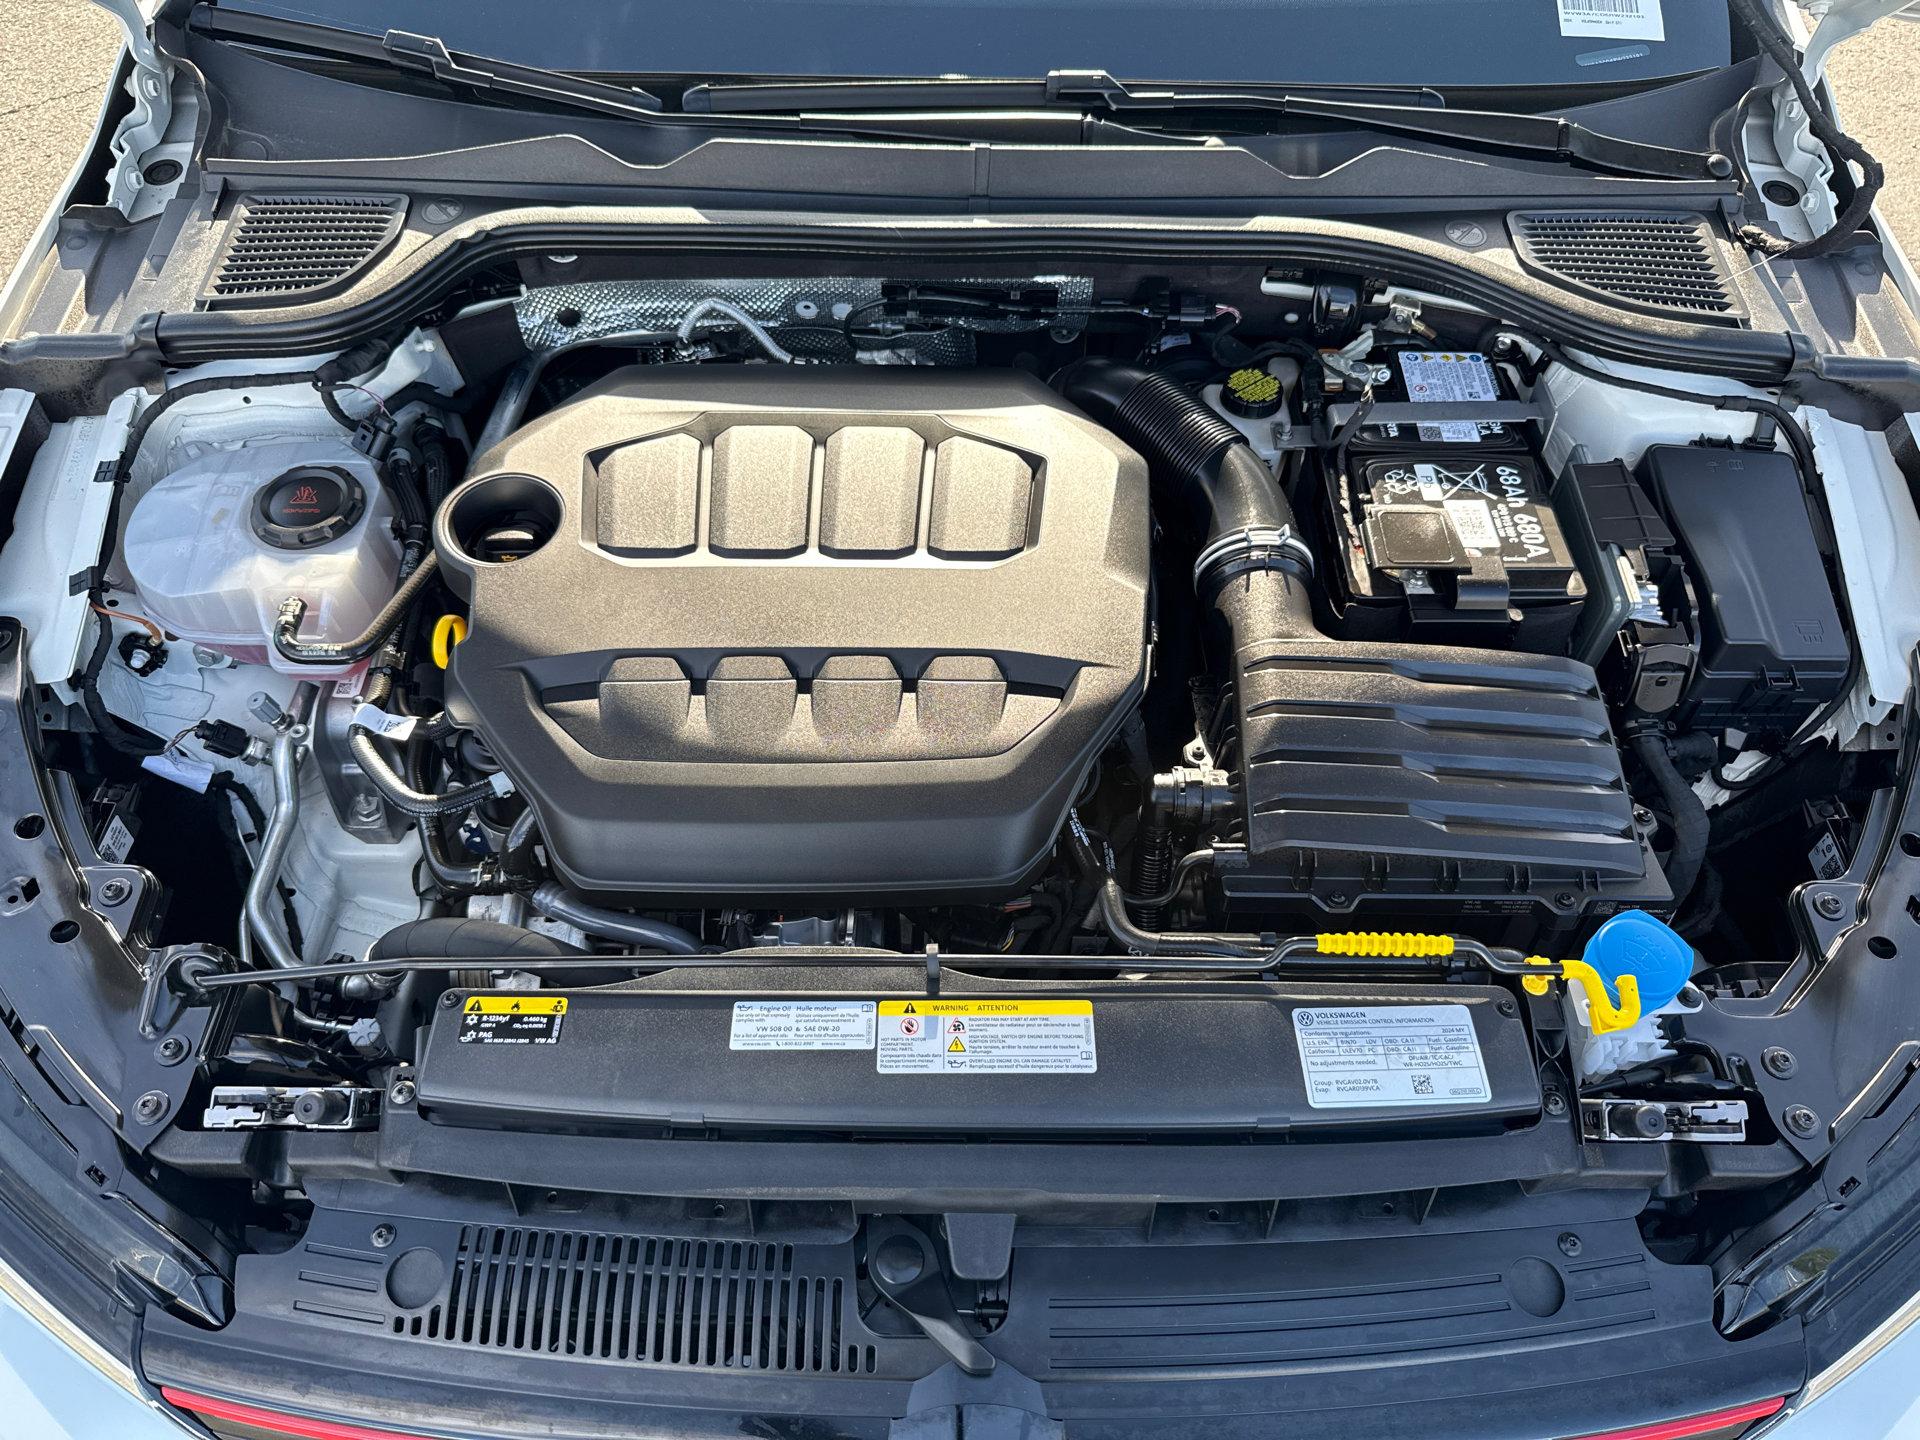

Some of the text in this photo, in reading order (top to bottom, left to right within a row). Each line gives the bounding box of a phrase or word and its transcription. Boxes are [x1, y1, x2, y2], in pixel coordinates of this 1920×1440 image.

[1387, 422, 1399, 438] RTA
[1420, 475, 1434, 490] Pb
[1496, 466, 1550, 558] 68Ah 680A
[482, 1015, 511, 1023] R-1234yf
